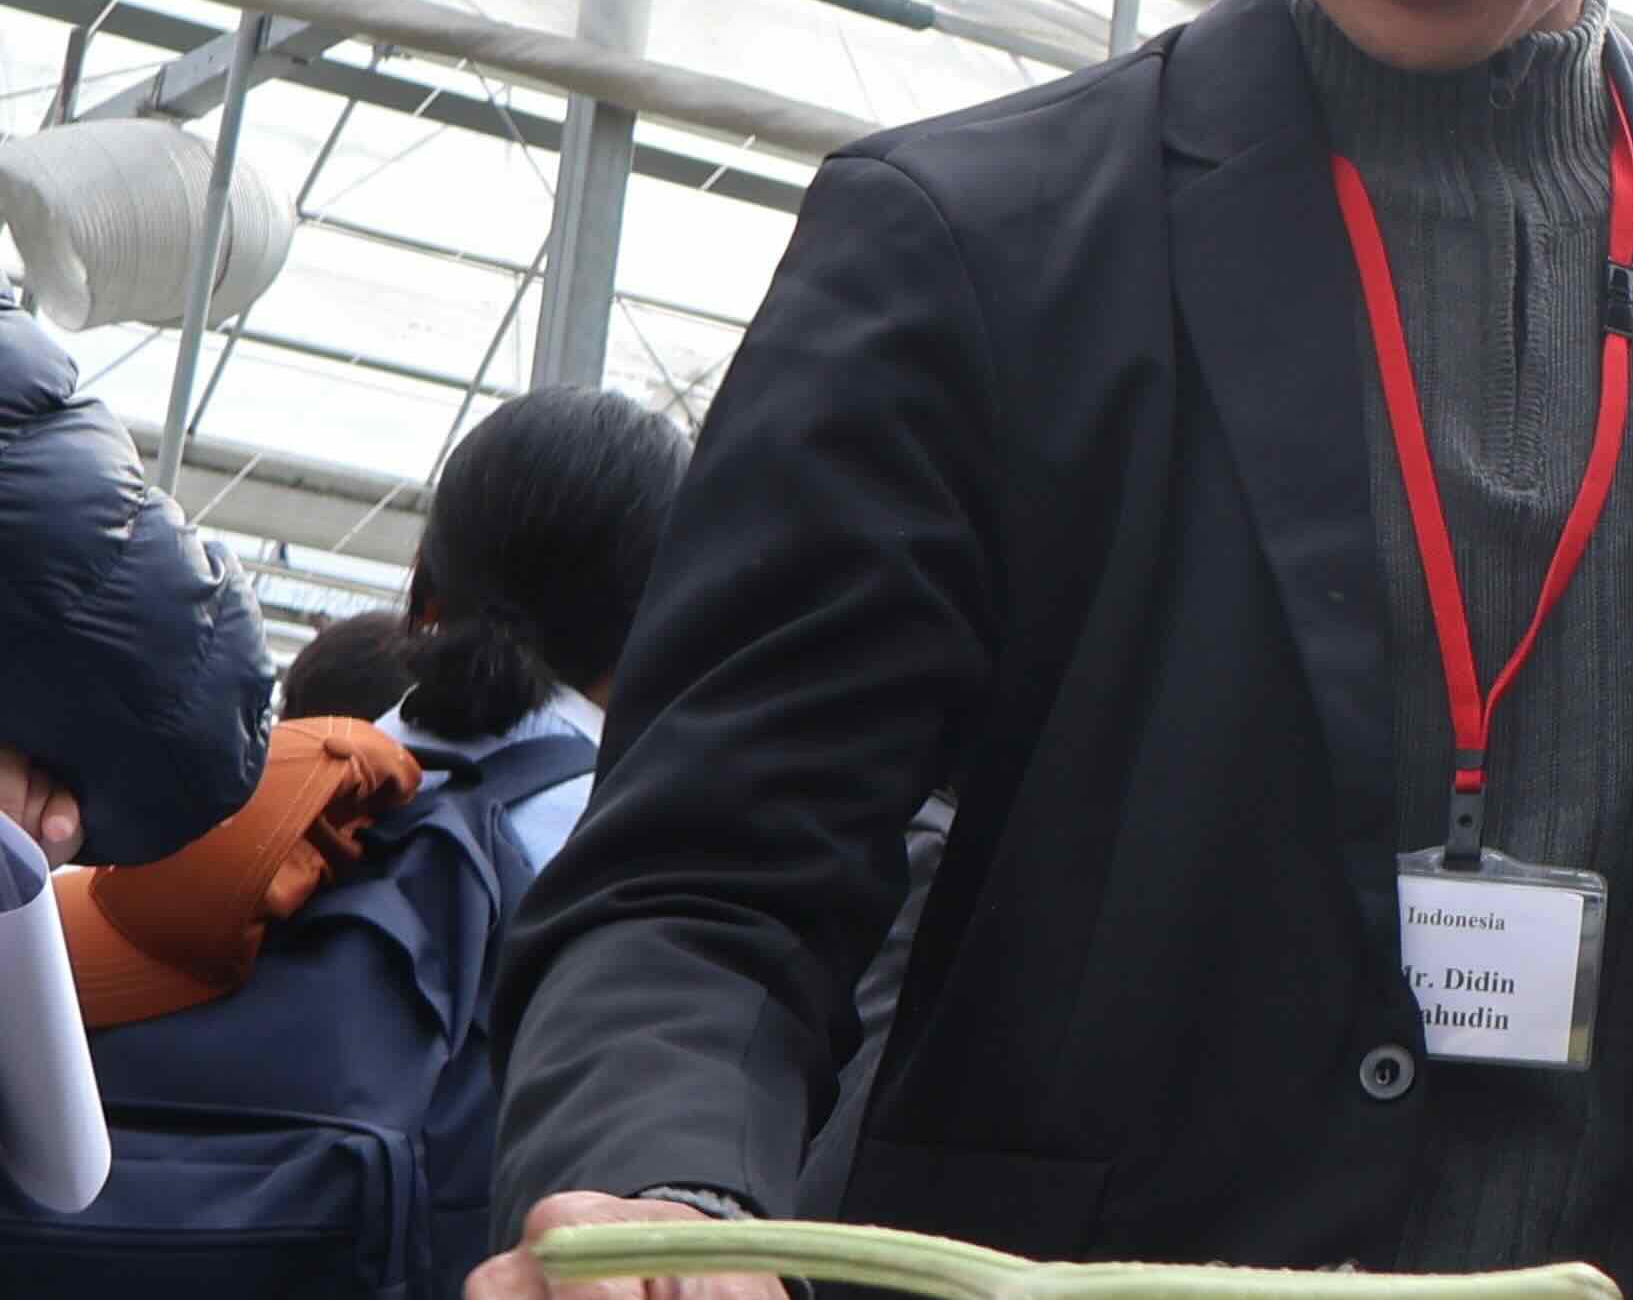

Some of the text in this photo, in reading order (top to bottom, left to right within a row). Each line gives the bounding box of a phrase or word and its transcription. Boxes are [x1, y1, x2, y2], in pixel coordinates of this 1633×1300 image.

[1407, 906, 1505, 931] Indonesia
[1445, 967, 1515, 995] Didin
[1421, 1004, 1509, 1030] ahudin
